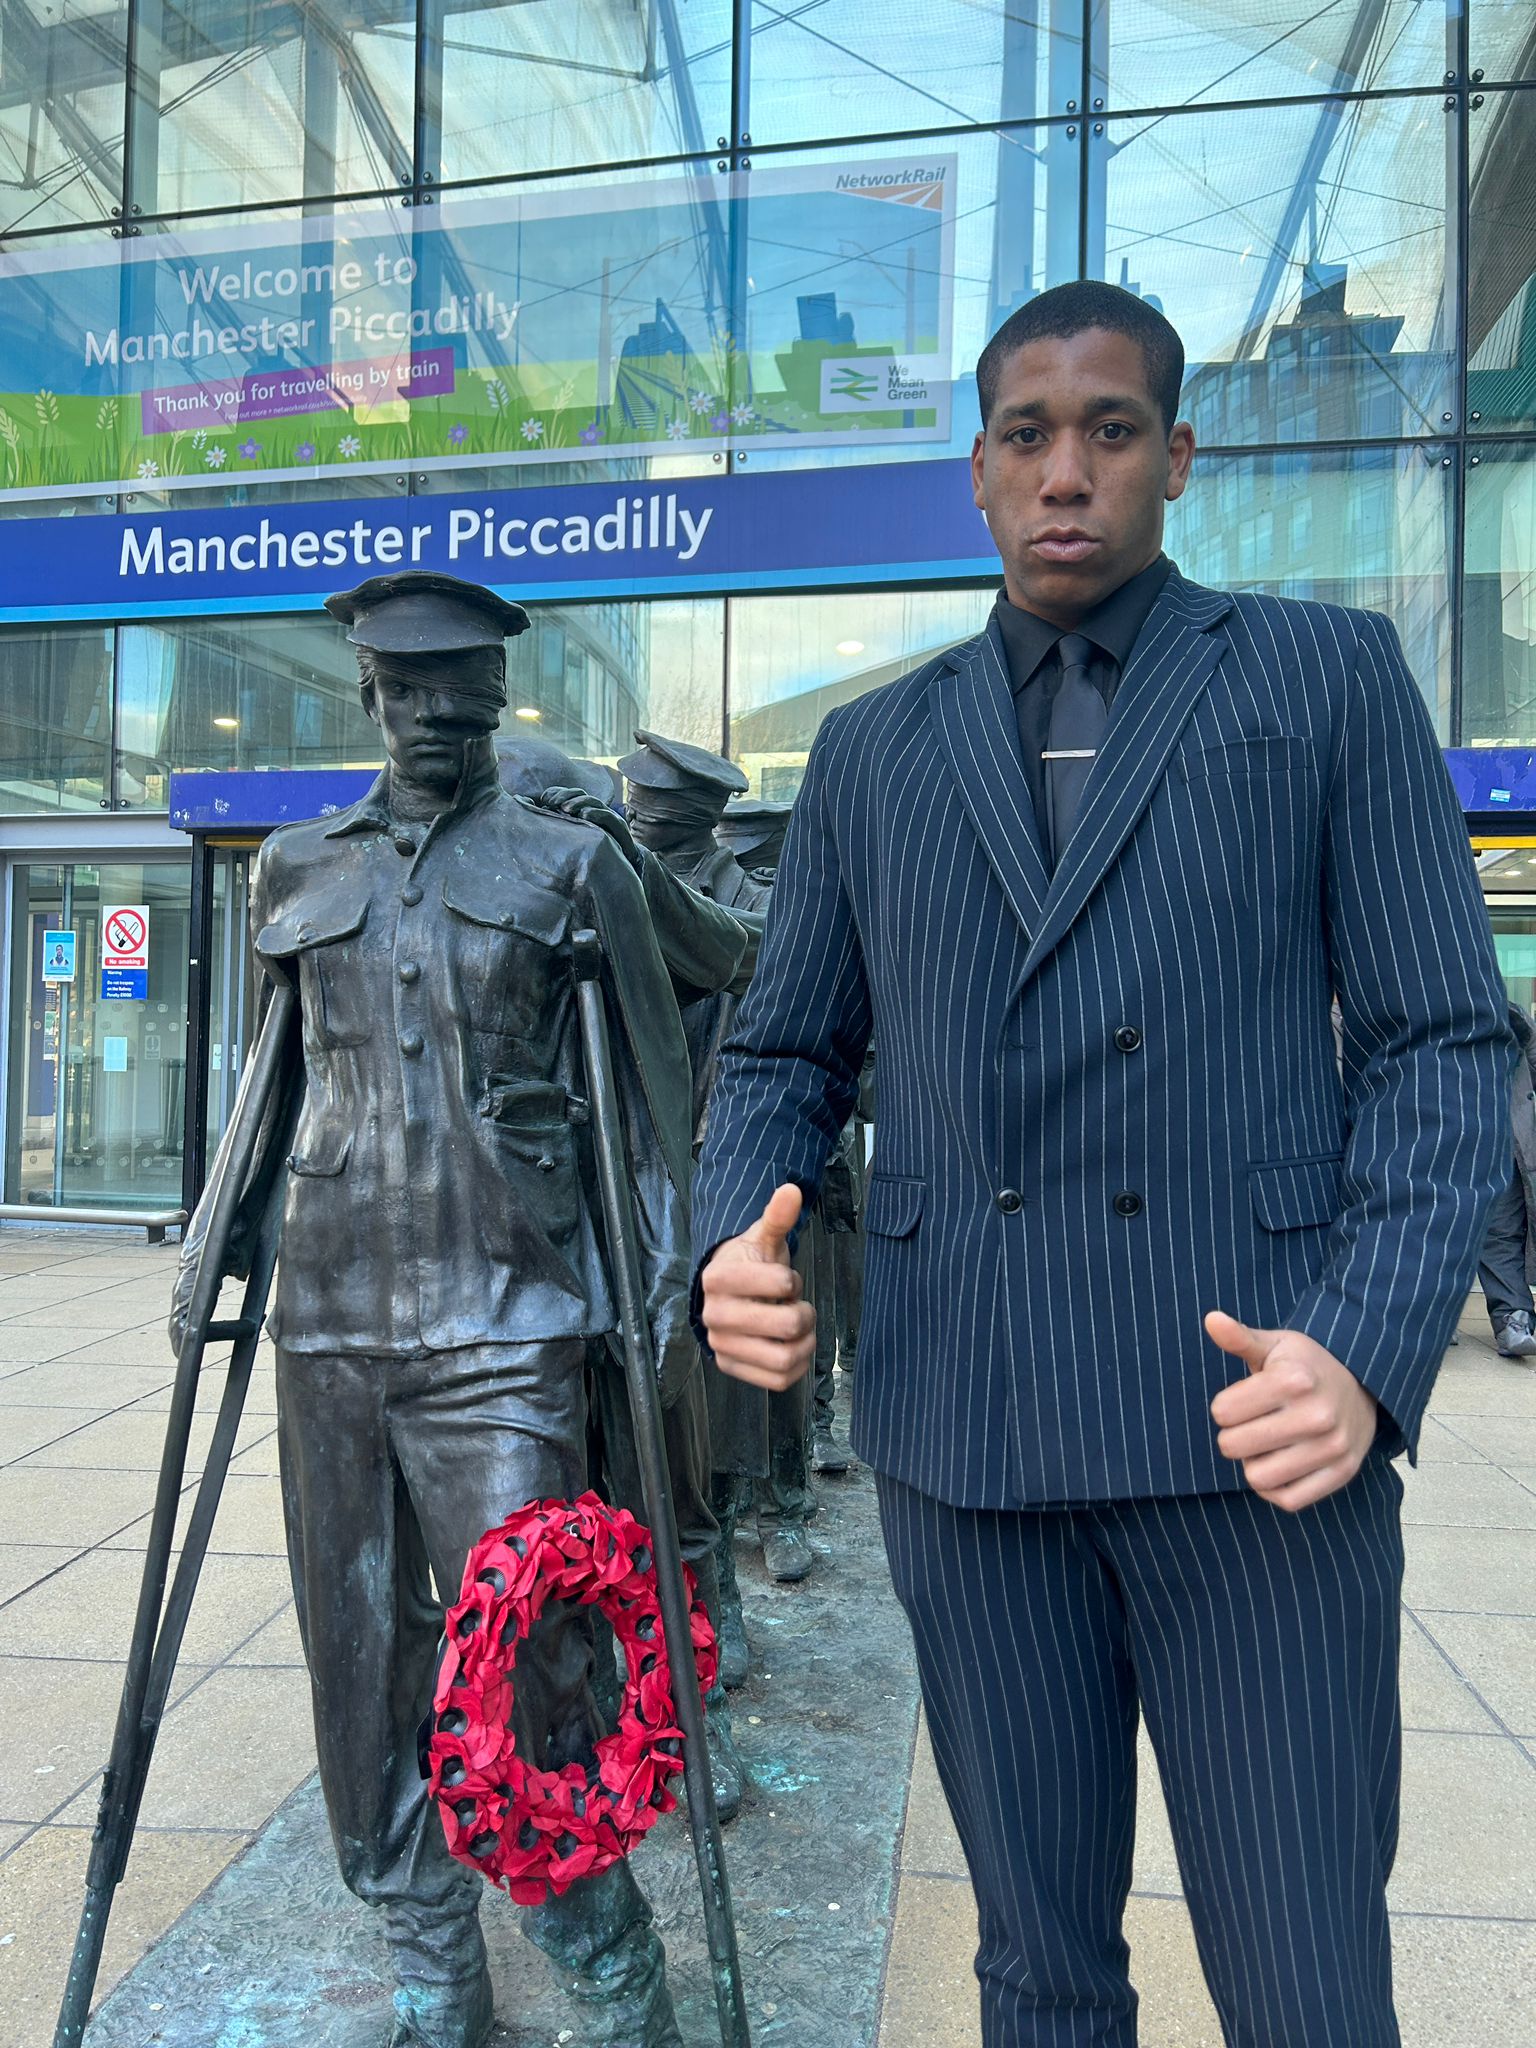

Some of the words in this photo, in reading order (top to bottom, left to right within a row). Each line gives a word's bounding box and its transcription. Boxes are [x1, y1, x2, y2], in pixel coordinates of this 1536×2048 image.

[836, 166, 946, 189] NetworkRail
[178, 261, 362, 305] Welcome
[374, 252, 418, 287] to
[84, 317, 316, 367] Manchester
[329, 291, 521, 345] Piccadilly
[887, 365, 909, 377] We
[153, 390, 209, 414] Thank
[213, 389, 246, 411] you
[250, 382, 276, 401] for
[280, 372, 364, 397] travelling
[369, 366, 391, 387] by
[396, 359, 440, 380] train
[887, 377, 925, 389] Mean
[887, 388, 928, 400] Green
[239, 410, 250, 420] out
[250, 407, 267, 417] more
[119, 518, 432, 576] Manchester
[448, 493, 714, 561] Piccadilly
